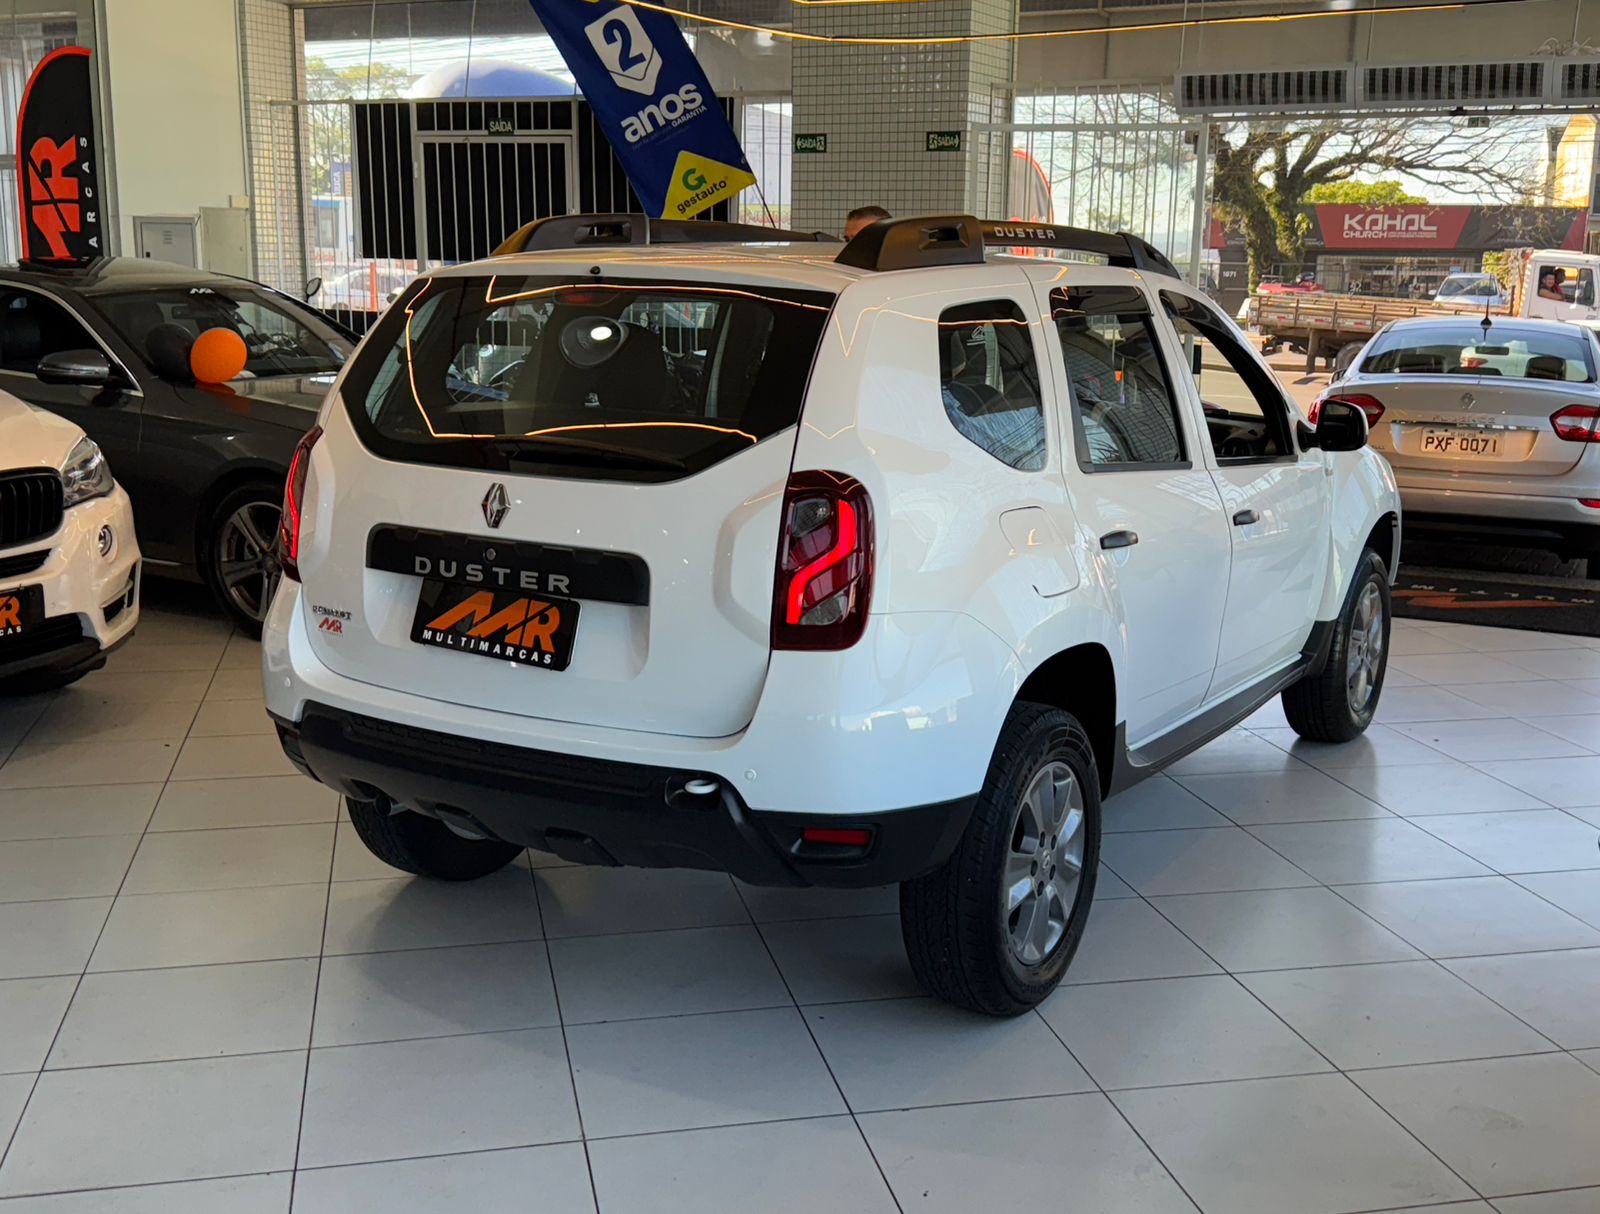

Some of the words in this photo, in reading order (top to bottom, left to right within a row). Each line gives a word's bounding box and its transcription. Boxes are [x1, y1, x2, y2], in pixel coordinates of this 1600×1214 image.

[603, 19, 646, 72] 2
[620, 83, 703, 143] anos
[671, 105, 708, 127] GARANTIA
[677, 178, 728, 214] gestauto
[994, 226, 1056, 240] DUSTER
[1343, 213, 1438, 231] KAHAL
[1343, 230, 1387, 239] CHURCH
[415, 556, 570, 594] DUSTER
[422, 629, 552, 664] MULTIMARCAS
